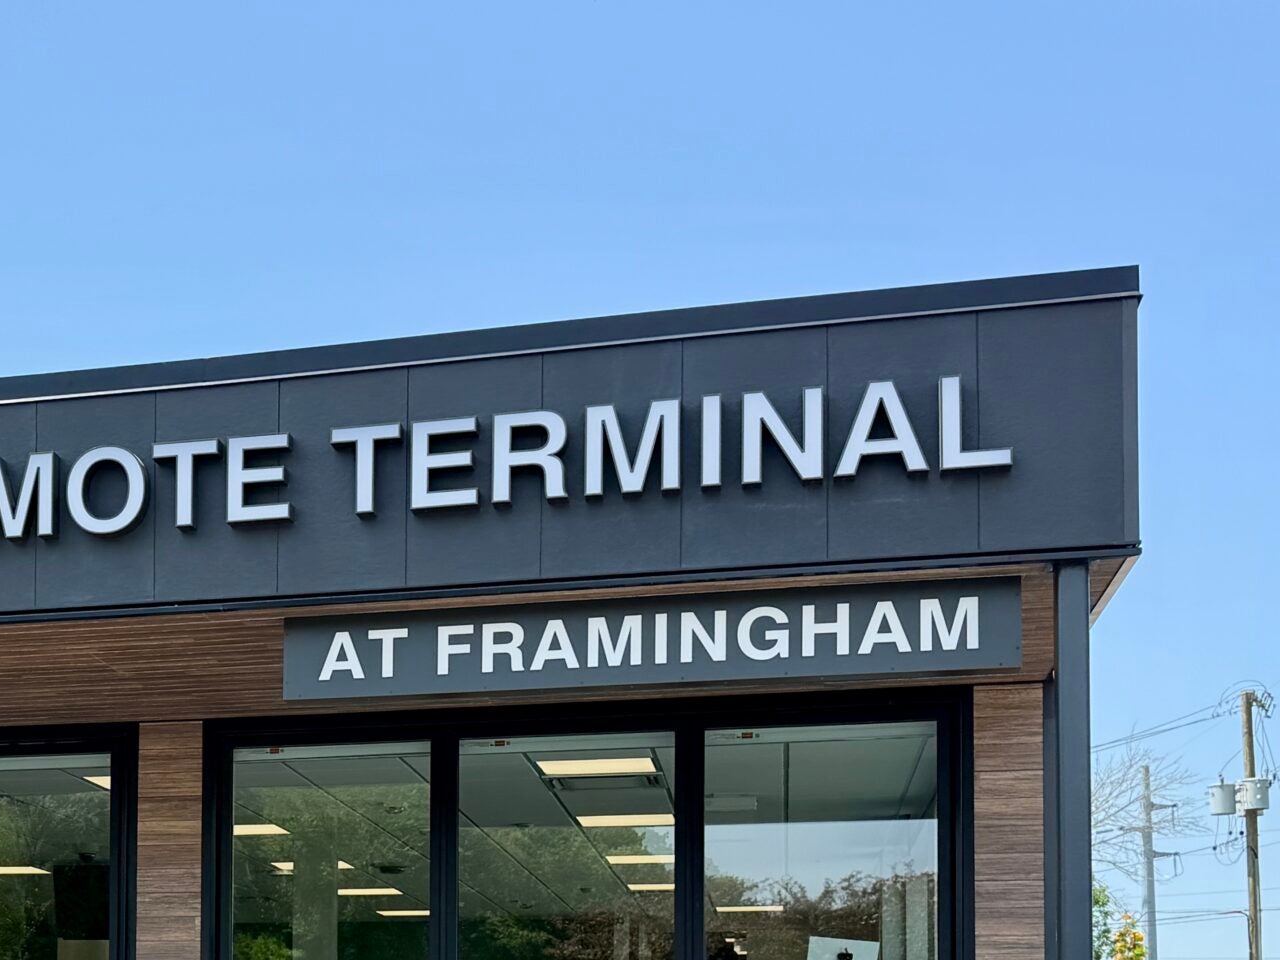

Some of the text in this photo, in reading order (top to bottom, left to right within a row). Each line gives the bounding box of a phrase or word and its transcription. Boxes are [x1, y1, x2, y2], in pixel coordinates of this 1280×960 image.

[330, 374, 1014, 519] TERMINAL
[318, 595, 981, 681] AT FRAMINGHAM
